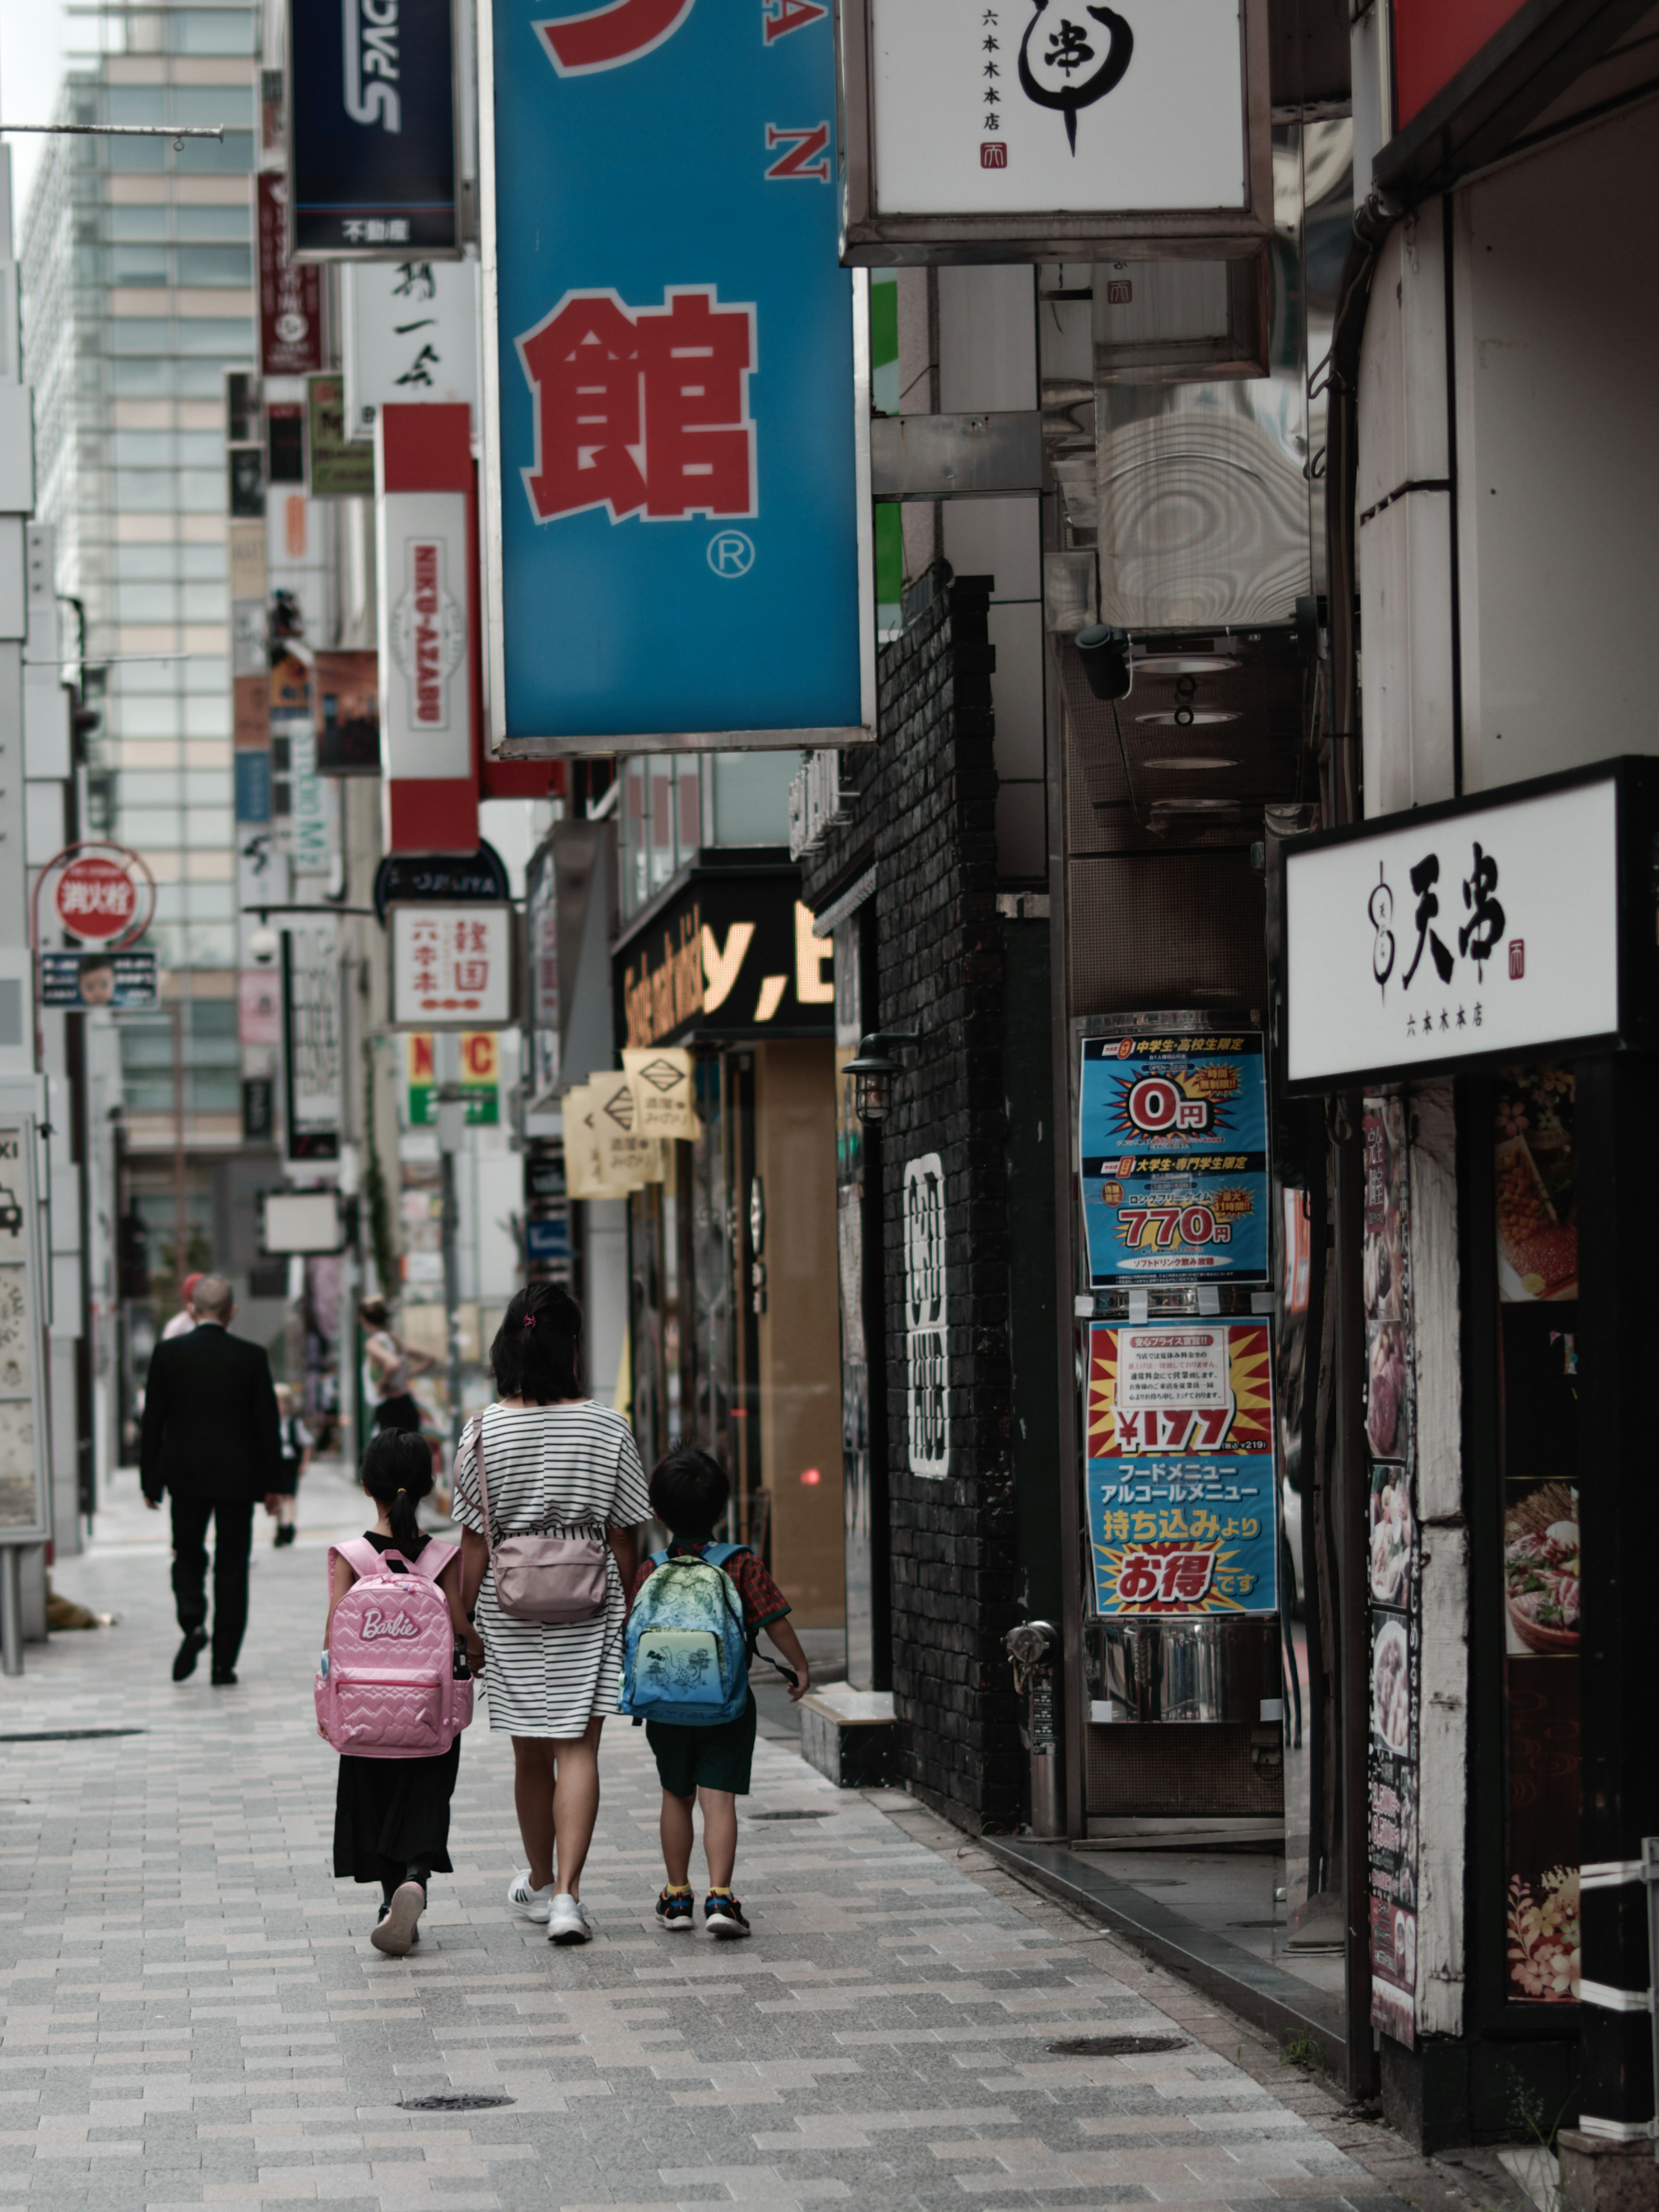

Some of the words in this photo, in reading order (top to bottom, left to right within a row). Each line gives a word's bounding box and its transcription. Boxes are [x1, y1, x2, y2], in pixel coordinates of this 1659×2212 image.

[1044, 19, 1095, 77] 串
[982, 10, 1001, 131] 六本木本店
[343, 219, 410, 242] 不動産
[414, 546, 439, 722] NIKU-AZABU
[1402, 842, 1506, 990] 天串
[1406, 1001, 1484, 1037] 六本木本店
[1137, 1038, 1244, 1053] 中学生・高校生限定
[1137, 1156, 1248, 1172] 大学生・専門学生限定
[1129, 1192, 1211, 1205] ロングフリータイム
[1119, 1206, 1232, 1247] 770円
[1134, 1255, 1214, 1268] ソフトドリンク飲み放題
[1135, 1336, 1207, 1347] 安心プライス宣言!!
[1130, 1371, 1217, 1380] 通常料金にて営業致します。
[1118, 1465, 1238, 1483] フードメニュー
[1100, 1484, 1259, 1505] アルコールメニュー
[1103, 1509, 1259, 1541] 持ち込みより
[1119, 1551, 1255, 1601] お得です
[362, 1610, 418, 1639] Barbie
